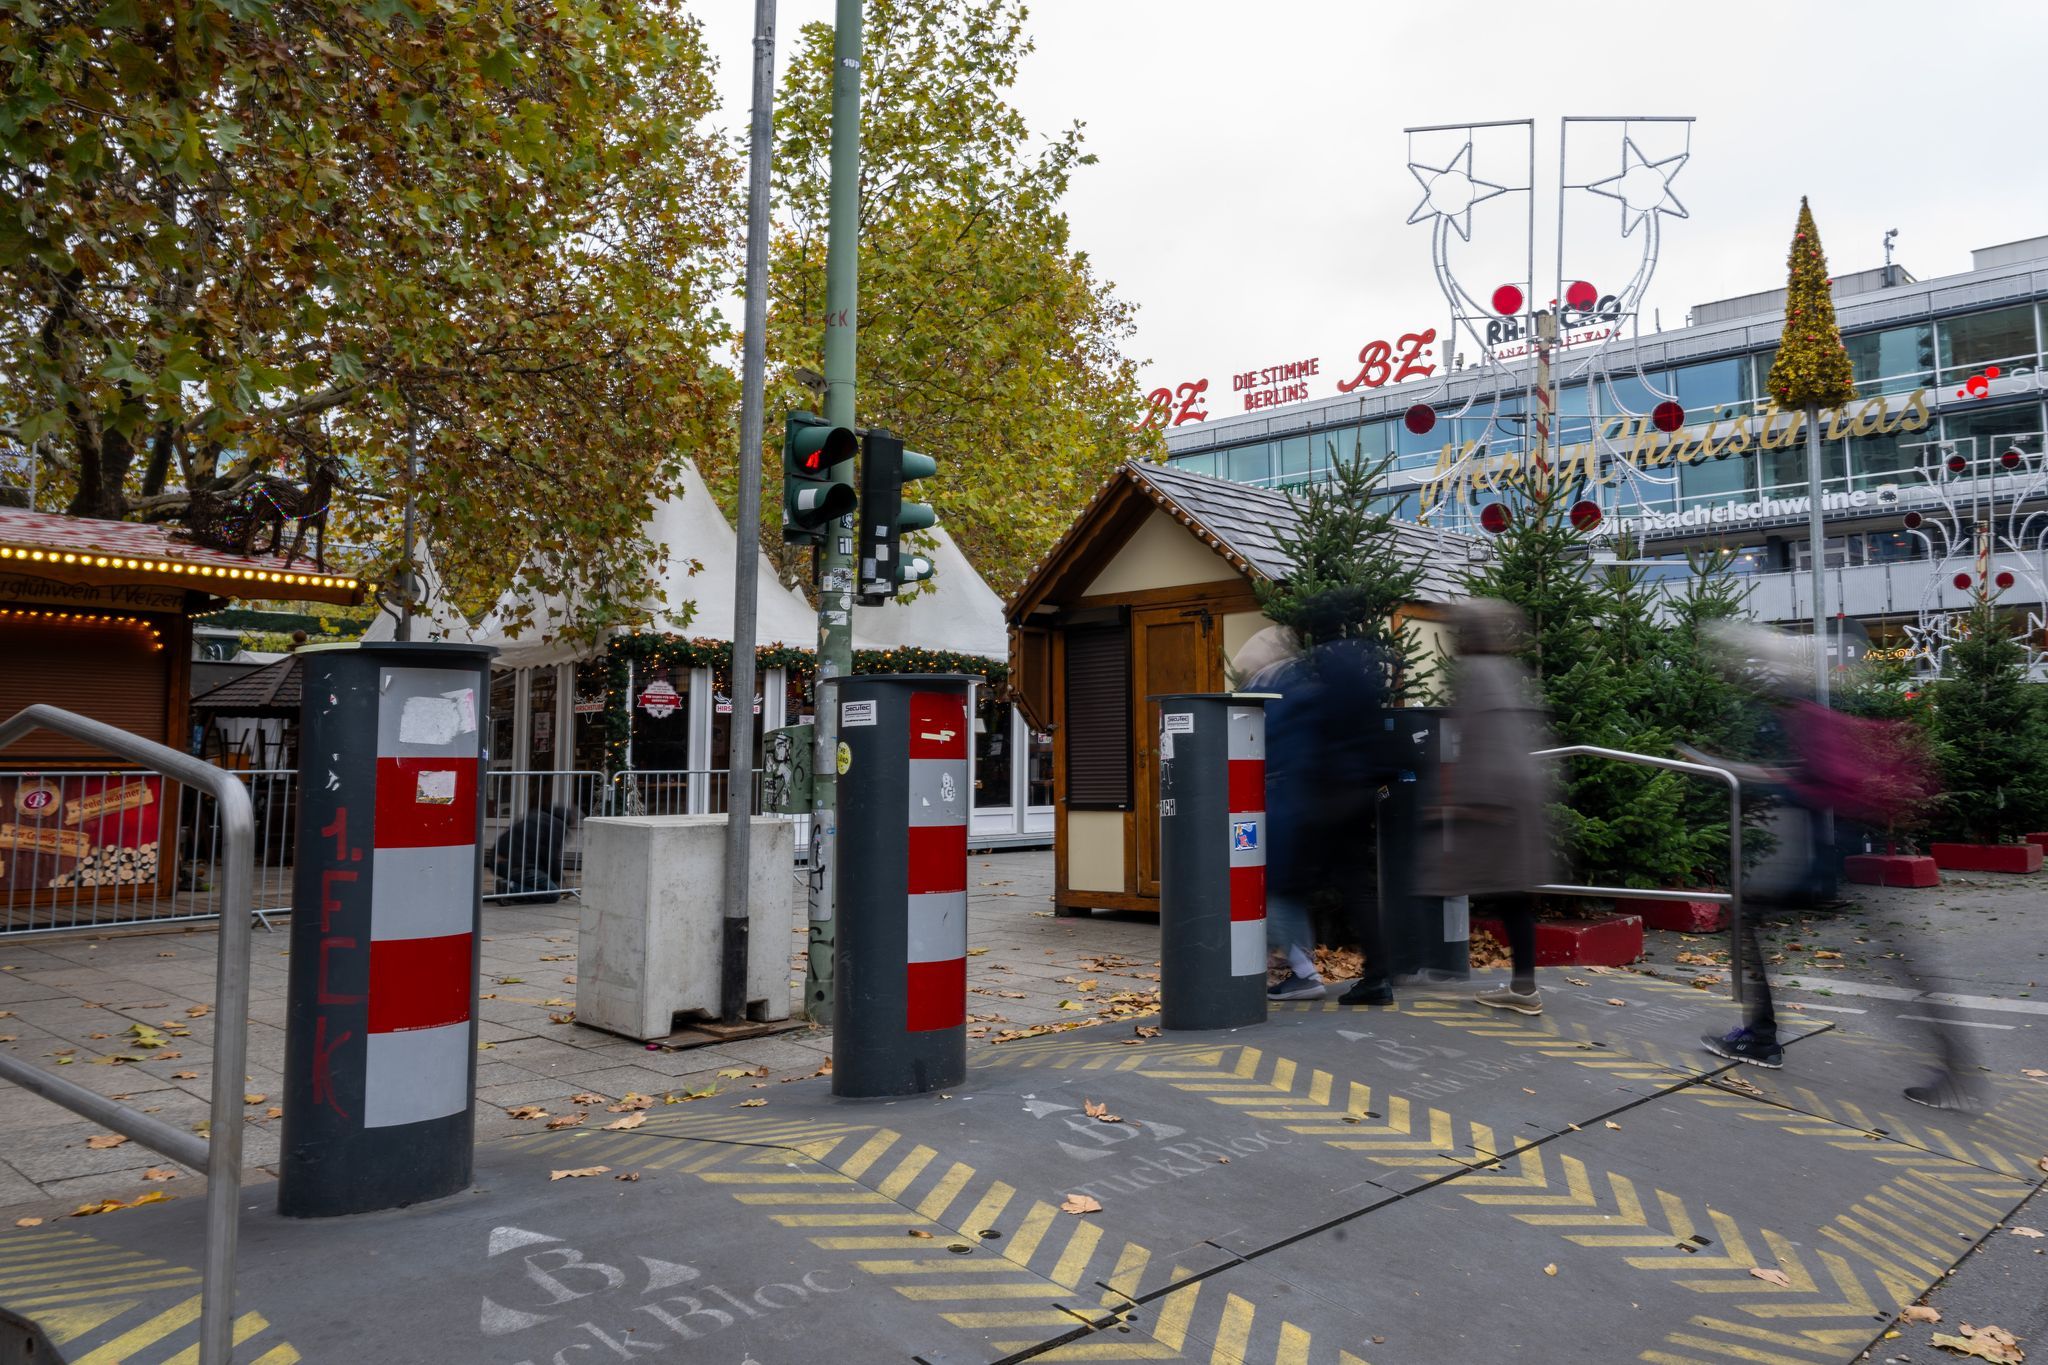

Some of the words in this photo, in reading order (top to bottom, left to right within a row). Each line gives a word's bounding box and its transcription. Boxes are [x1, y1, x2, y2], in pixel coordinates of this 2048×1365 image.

[1233, 371, 1257, 392] DIE
[1261, 358, 1320, 385] STIMME
[1243, 382, 1309, 411] BERLINS
[1585, 387, 1930, 485] Christmas
[524, 1248, 626, 1306] B
